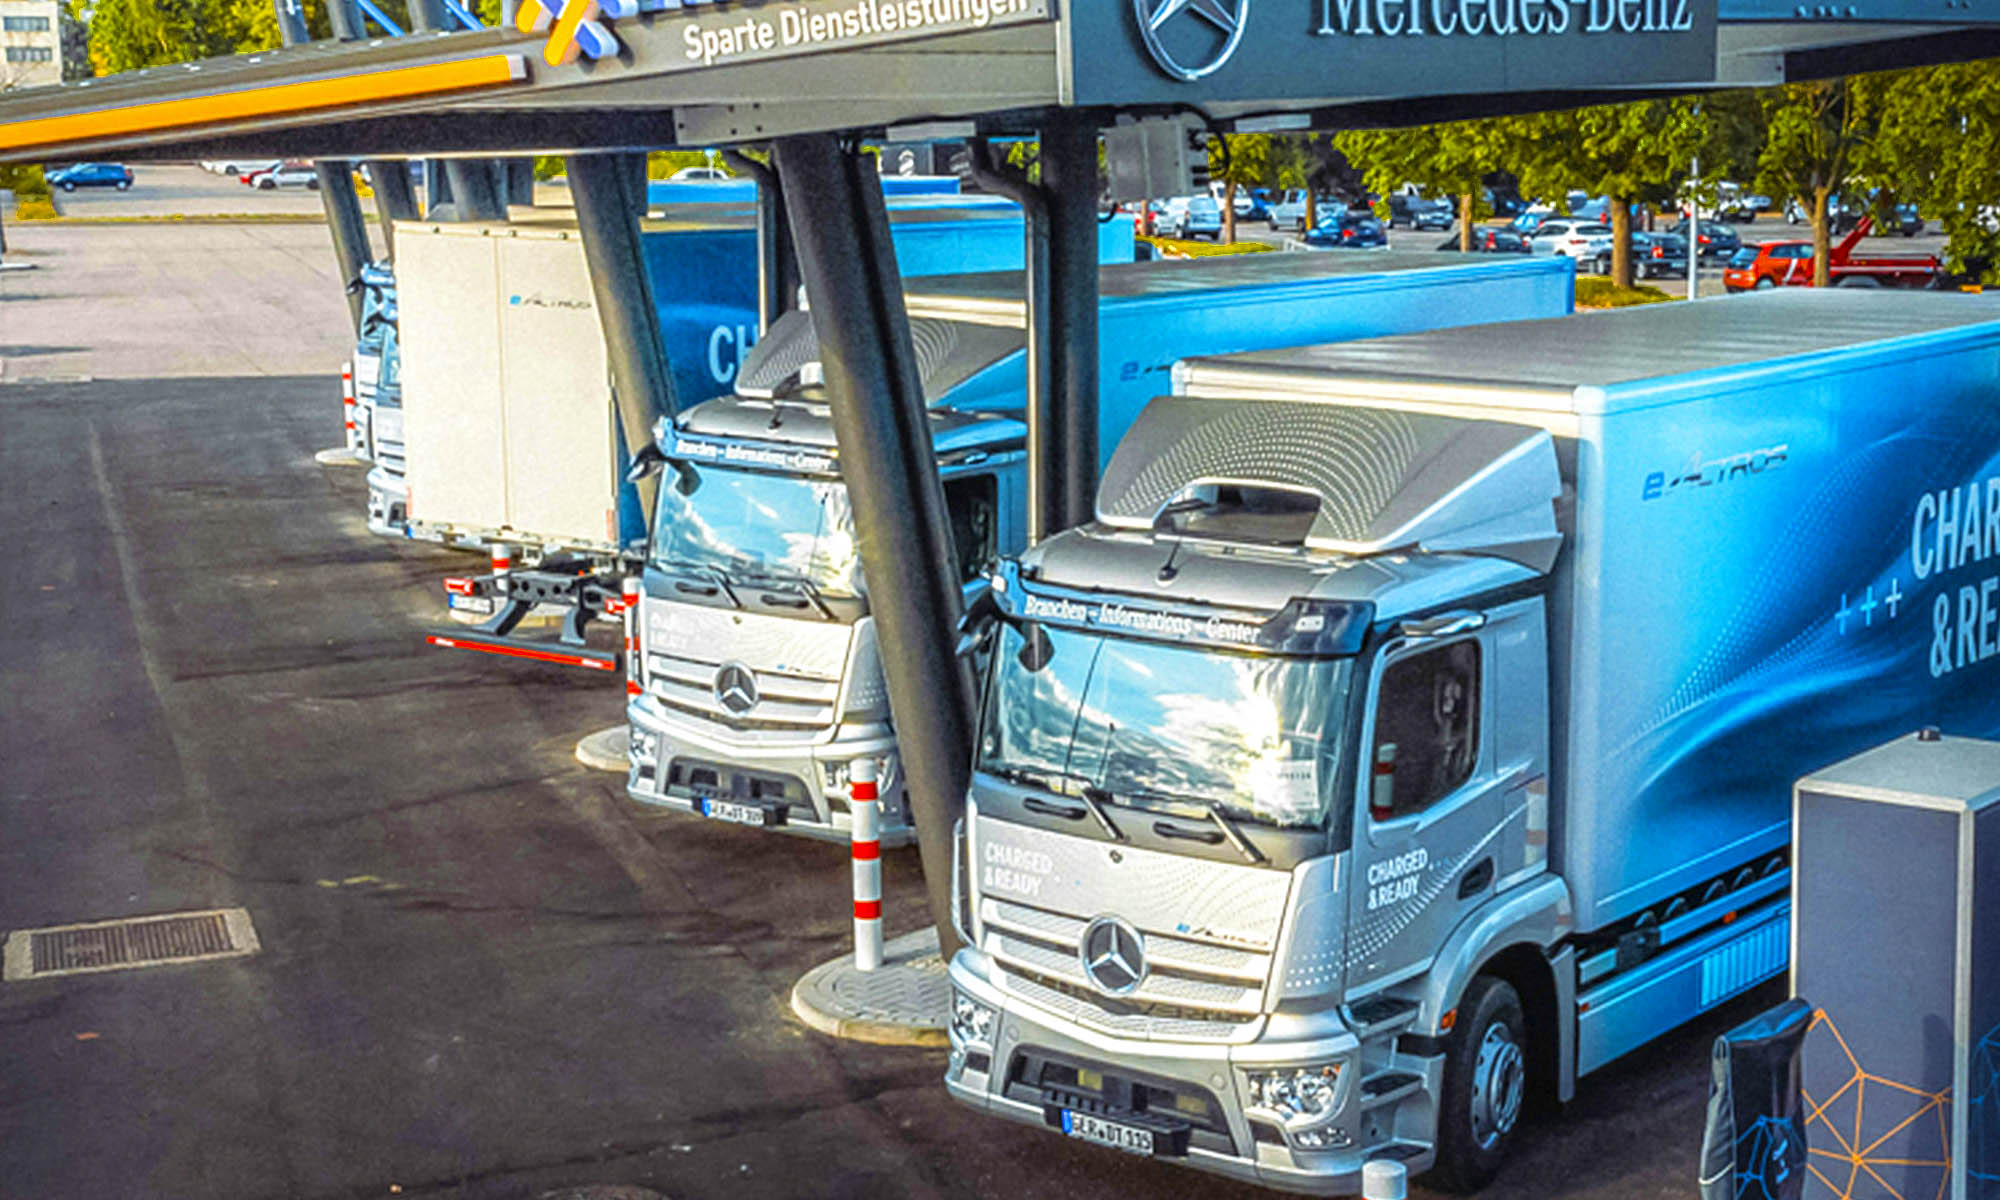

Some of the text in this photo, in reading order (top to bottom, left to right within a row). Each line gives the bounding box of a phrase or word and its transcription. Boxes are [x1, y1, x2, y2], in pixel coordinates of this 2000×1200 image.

[683, 17, 775, 66] Sparte
[1023, 594, 1087, 622] Branchen
[1205, 615, 1262, 644] Center
[984, 841, 1054, 875] CHARGED
[1367, 847, 1428, 886] CHARGED
